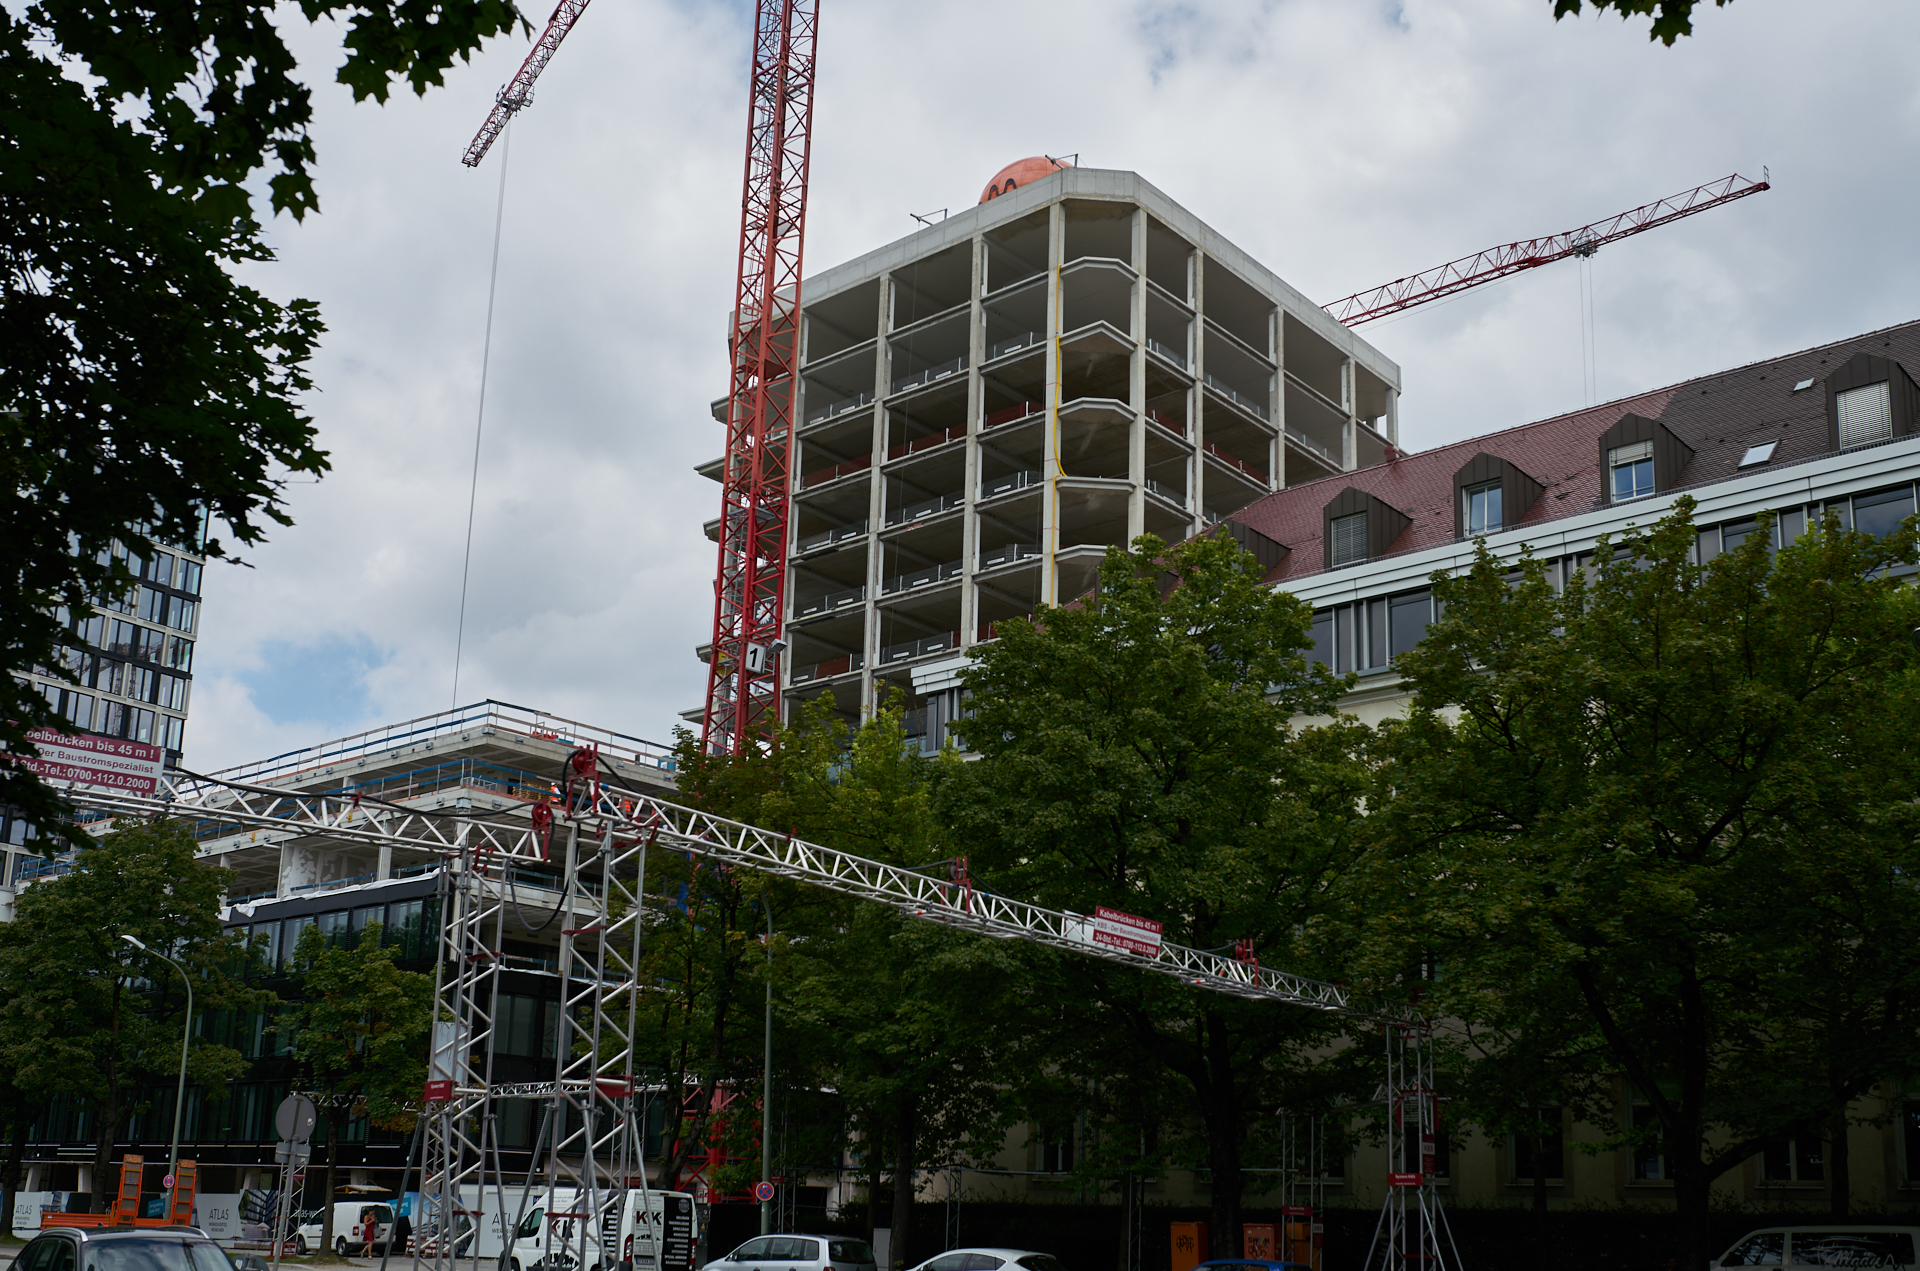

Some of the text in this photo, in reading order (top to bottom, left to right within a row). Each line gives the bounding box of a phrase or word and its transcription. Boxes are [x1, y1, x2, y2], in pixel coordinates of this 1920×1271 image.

[750, 648, 758, 667] 1
[97, 739, 116, 753] bis
[119, 744, 133, 756] 45
[136, 749, 147, 758] m
[57, 751, 154, 773] Baustromspezialist
[1100, 910, 1135, 925] Kabelbrücken
[1136, 919, 1144, 928] bis
[1097, 922, 1108, 930] KBS
[1111, 924, 1119, 933] Der
[1120, 927, 1159, 943] Baustromspezialist
[15, 1204, 33, 1215] ATLAS
[209, 1208, 230, 1220] ATLAS
